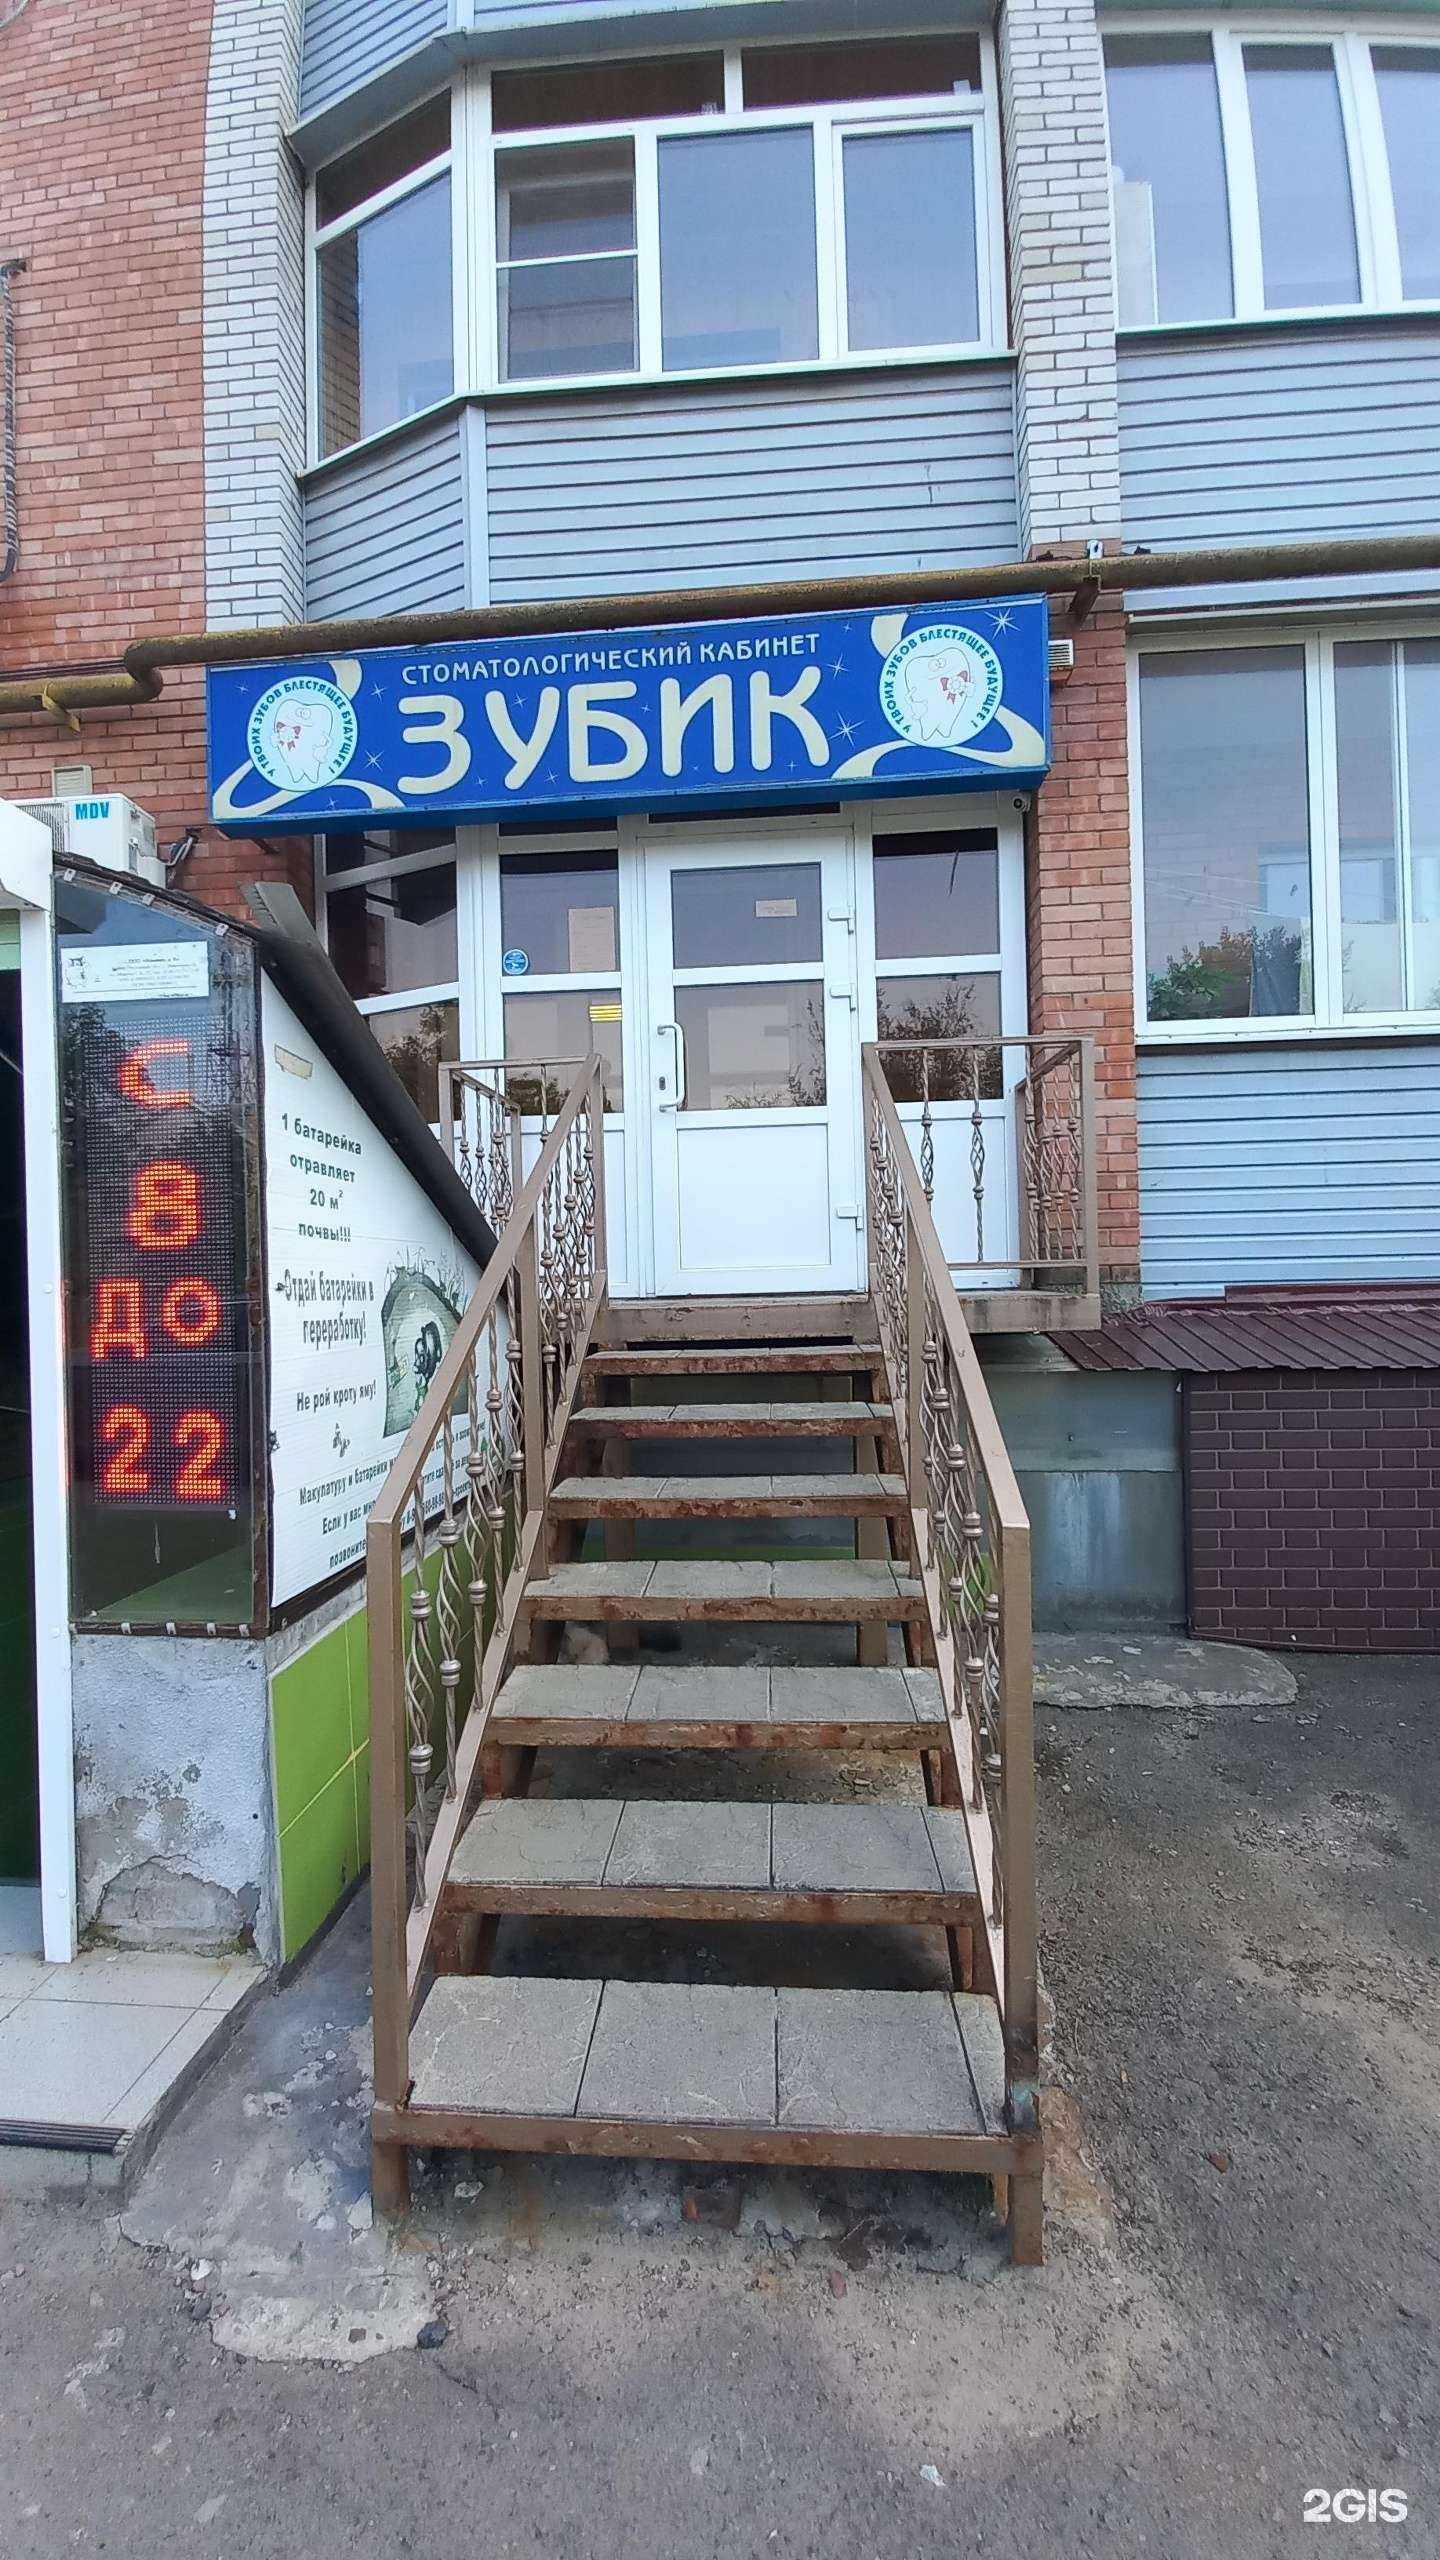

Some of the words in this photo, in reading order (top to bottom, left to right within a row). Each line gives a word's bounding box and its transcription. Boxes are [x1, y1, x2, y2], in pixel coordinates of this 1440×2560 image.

[402, 640, 692, 685] СТОМАТОЛОГИЧЕСКИЙ
[700, 632, 820, 664] КАБИНЕТ
[886, 638, 918, 678] ЗУБОВ
[919, 628, 989, 659] БЛЕСТЯЩЕЕ
[254, 688, 282, 724] ЗУБОВ
[284, 680, 346, 709] БЛЕСТЯЩЕЕ
[884, 680, 904, 725] ТВОИХ
[251, 727, 269, 770] ТВОИХ
[397, 665, 830, 796] ЗУБИК
[75, 802, 110, 820] MDV
[120, 1039, 192, 1106] С
[281, 1113, 288, 1131] 1
[294, 1118, 362, 1155] батарейка
[290, 1154, 355, 1183] отравляет
[310, 1188, 325, 1207] 20
[298, 1223, 351, 1242] почвы!!!
[284, 1269, 317, 1307] Отдай
[319, 1271, 367, 1307] батарейки
[369, 1281, 374, 1301] в
[91, 1275, 222, 1360] ДО
[303, 1310, 367, 1350] переработку!
[296, 1391, 310, 1411] Не
[313, 1387, 330, 1413] рой
[333, 1386, 357, 1407] кроту
[359, 1379, 376, 1400] яму!
[102, 1402, 225, 1499] 22
[299, 1476, 346, 1505] Макулатуру
[348, 1473, 353, 1486] и
[354, 1460, 388, 1484] батарейки
[322, 1516, 341, 1535] Если
[343, 1513, 348, 1529] у
[349, 1506, 361, 1521] вас
[329, 1538, 367, 1568] позвоните
